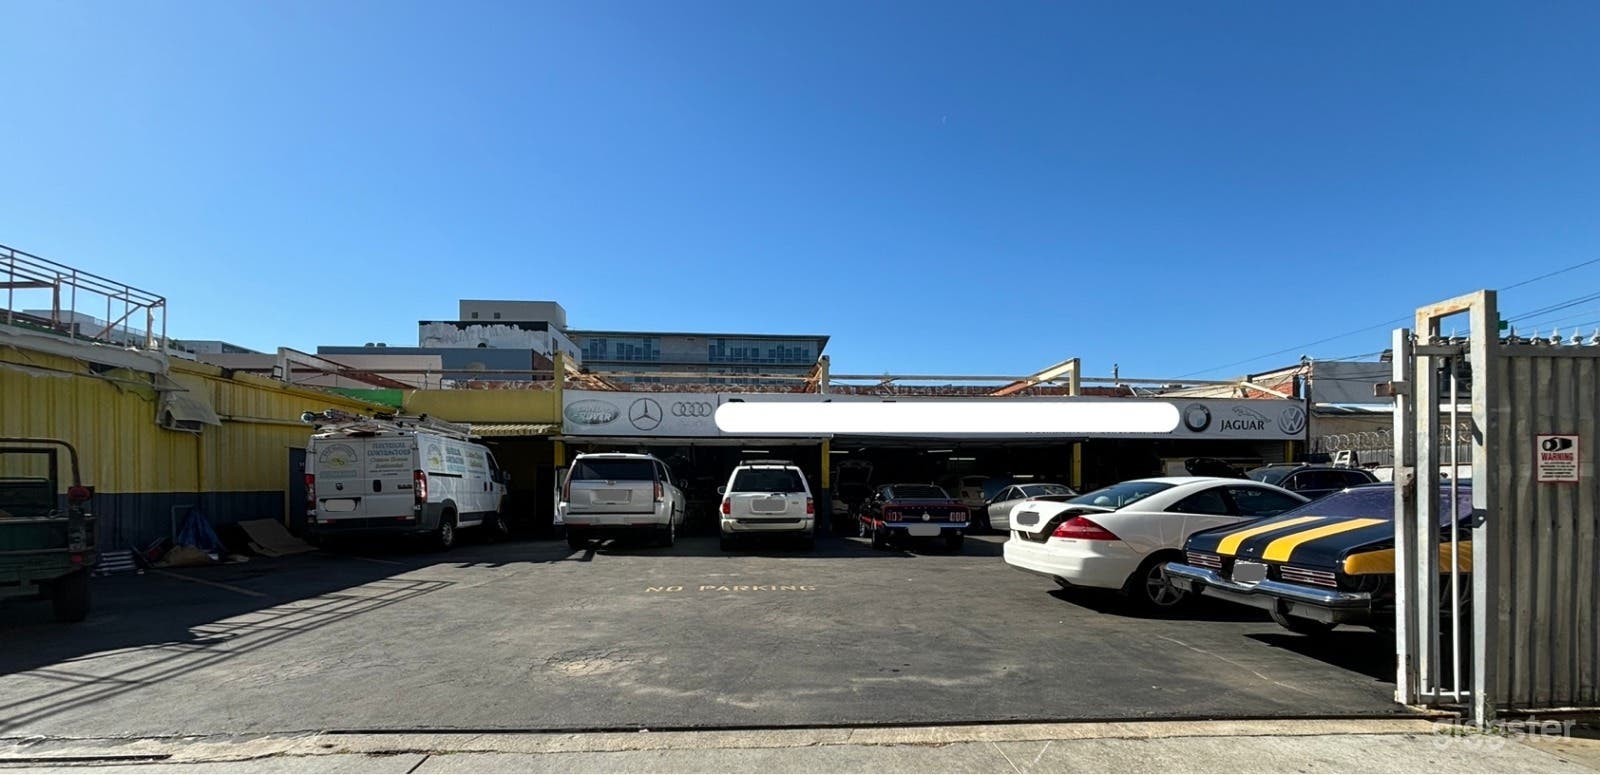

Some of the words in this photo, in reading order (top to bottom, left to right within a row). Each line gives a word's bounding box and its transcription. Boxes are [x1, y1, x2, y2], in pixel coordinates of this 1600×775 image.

[1219, 419, 1265, 432] JAGUAR
[1541, 453, 1574, 461] WARNING
[644, 585, 683, 593] NO
